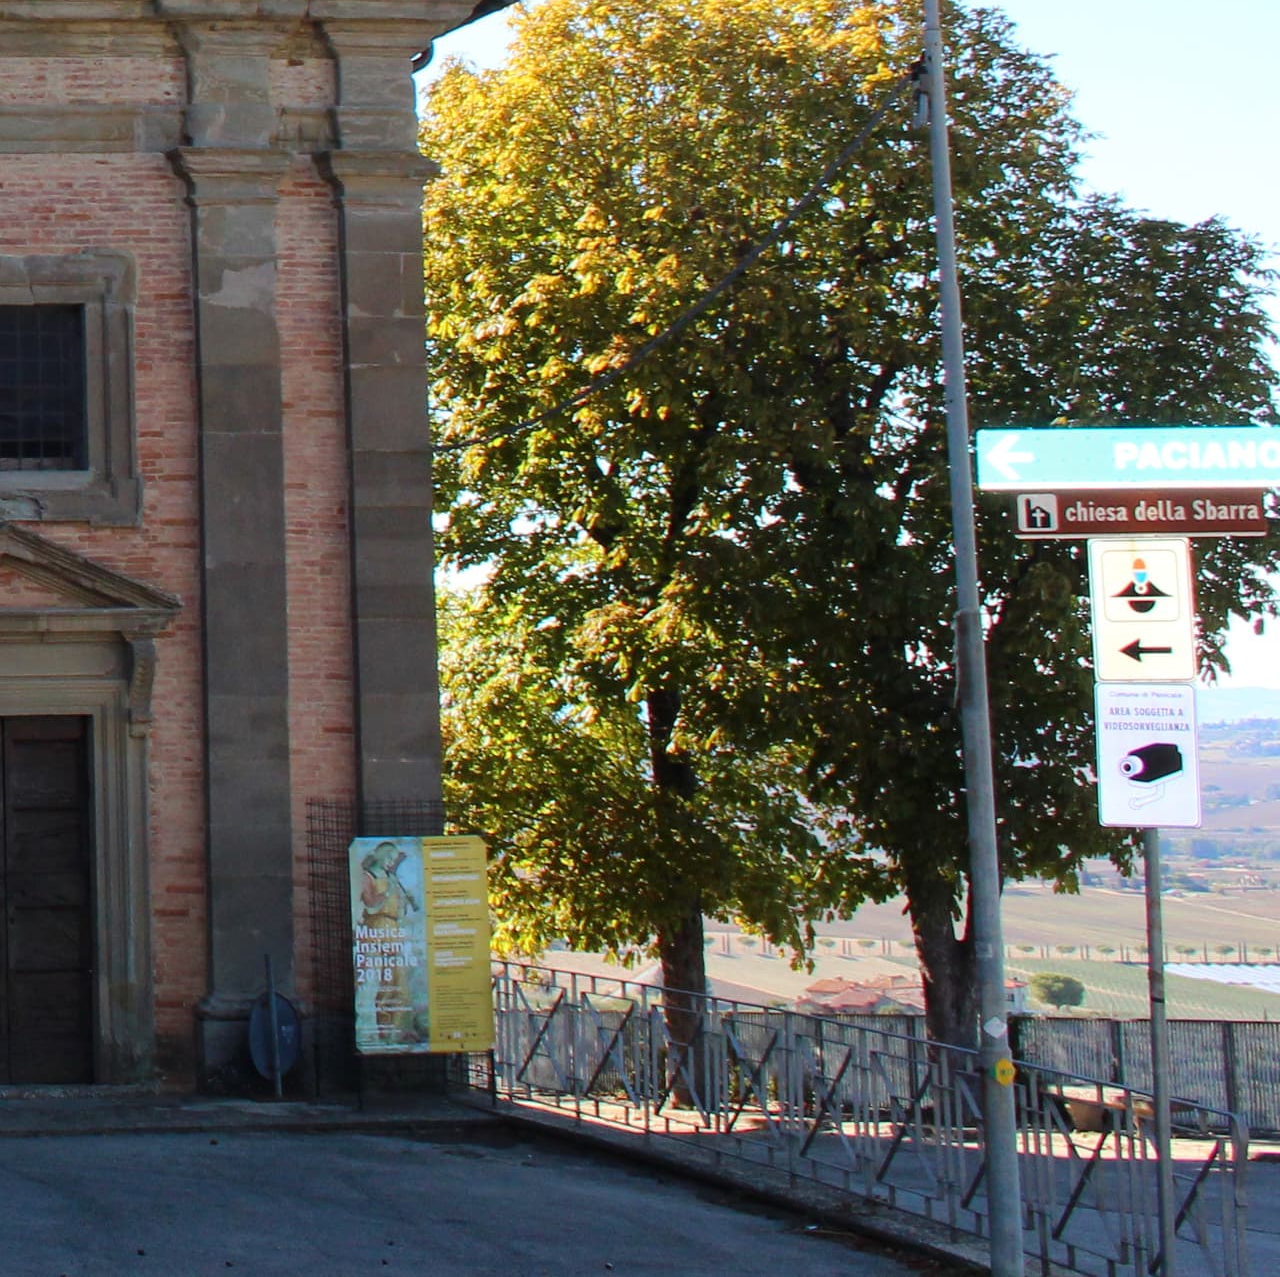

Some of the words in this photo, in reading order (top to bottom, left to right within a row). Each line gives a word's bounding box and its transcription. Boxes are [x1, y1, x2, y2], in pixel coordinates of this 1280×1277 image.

[1114, 441, 1280, 470] PACIANO
[1065, 501, 1128, 522] chiesa
[1134, 500, 1186, 521] della
[1192, 499, 1260, 520] Sbarra
[1109, 707, 1131, 716] AREA
[1134, 707, 1175, 717] SOGGETTA
[1177, 708, 1184, 717] A
[1104, 722, 1191, 732] VIDEOSORVEGLIANZA
[355, 924, 406, 939] Musica
[356, 953, 418, 968] Panicale
[357, 968, 393, 982] 2018
